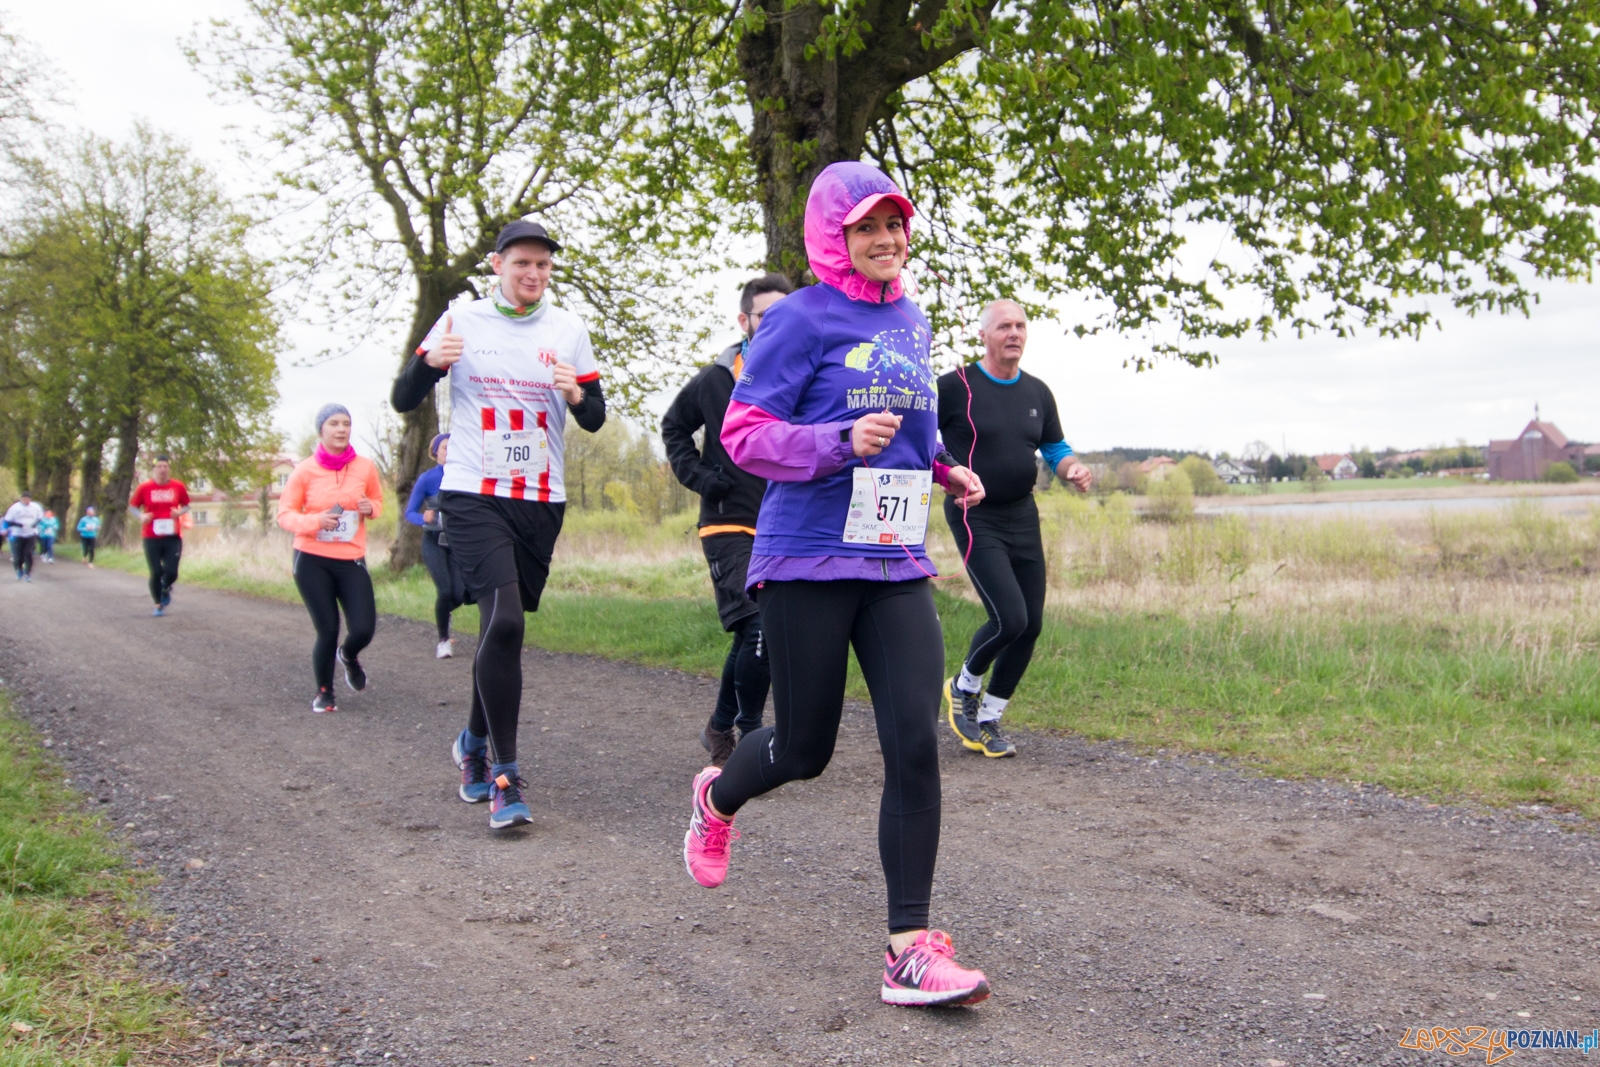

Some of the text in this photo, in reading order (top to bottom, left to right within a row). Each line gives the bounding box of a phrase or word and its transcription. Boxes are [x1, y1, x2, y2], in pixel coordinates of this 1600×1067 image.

[469, 375, 506, 384] POLONIA
[869, 386, 887, 394] 2013
[846, 394, 913, 409] MARATHON
[914, 396, 927, 410] DE
[504, 445, 530, 462] 760
[876, 496, 909, 522] 571
[862, 523, 877, 531] 5KM
